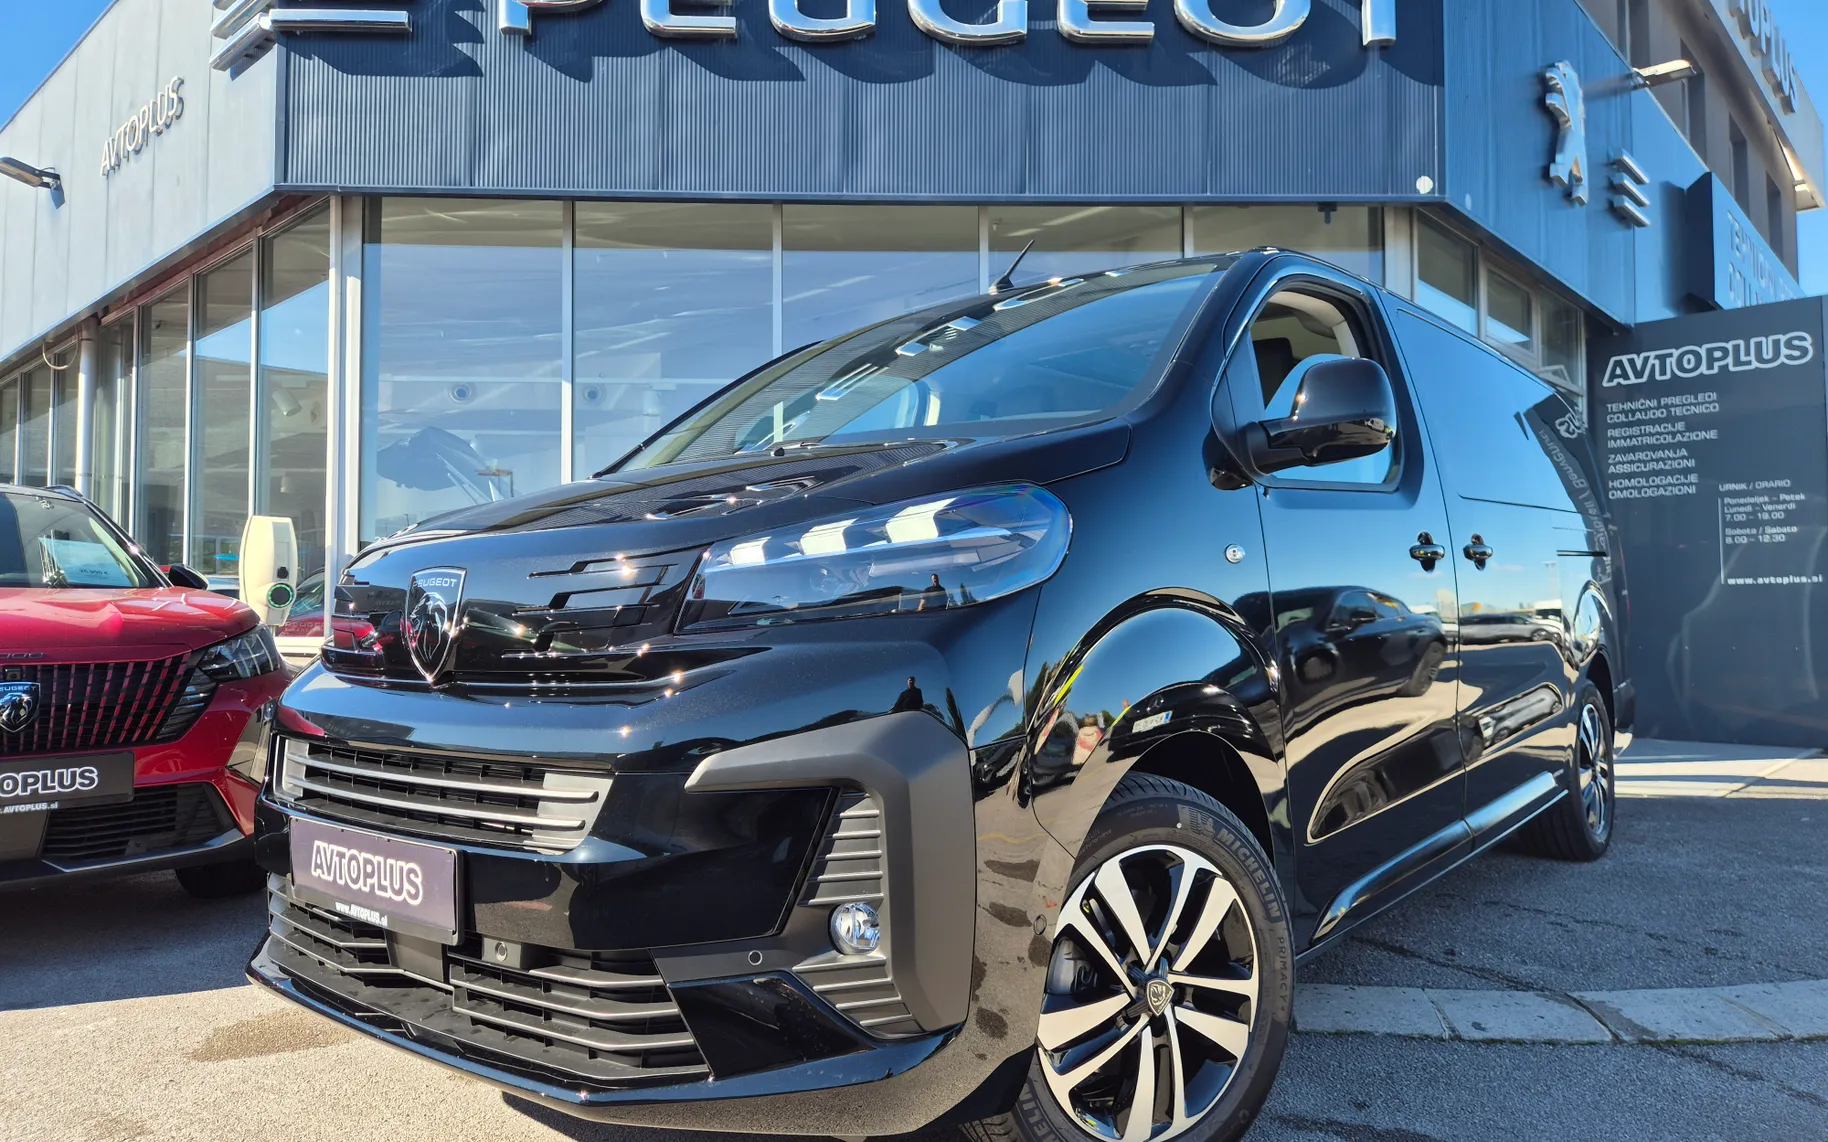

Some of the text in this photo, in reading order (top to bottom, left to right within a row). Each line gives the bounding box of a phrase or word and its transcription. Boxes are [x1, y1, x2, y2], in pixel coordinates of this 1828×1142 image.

[100, 76, 180, 177] AVTOPLUS
[1602, 331, 1813, 387] AVTOPLUS
[1606, 391, 1717, 412] TEHNIČNI PREGLEDI
[1606, 402, 1720, 423] COLLAUDO TECNICO
[1607, 421, 1686, 438] REGISTRACIJE
[1607, 429, 1718, 449] IMMATRICOLAZIONE
[1608, 447, 1689, 464] ZAVAROVANJA
[1608, 458, 1696, 474] ASSICURAZIONI
[1608, 473, 1699, 489] HOMOLOGACIJE
[1719, 482, 1747, 492] URNIK
[1755, 478, 1791, 489] ORARIO
[1608, 484, 1696, 500] OMOLOGAZIONI
[1779, 492, 1806, 502] Petek
[1725, 513, 1746, 522] 7.00
[1725, 527, 1757, 536] Sobota
[412, 577, 458, 588] PEUGEOT
[1727, 574, 1823, 585] www.avtoplus.si
[311, 840, 423, 906] AVTOPLUS
[1216, 827, 1281, 918] MICHELIN
[335, 902, 388, 927] www.AVTOPLUS.si
[1277, 936, 1289, 1002] PRIMACY
